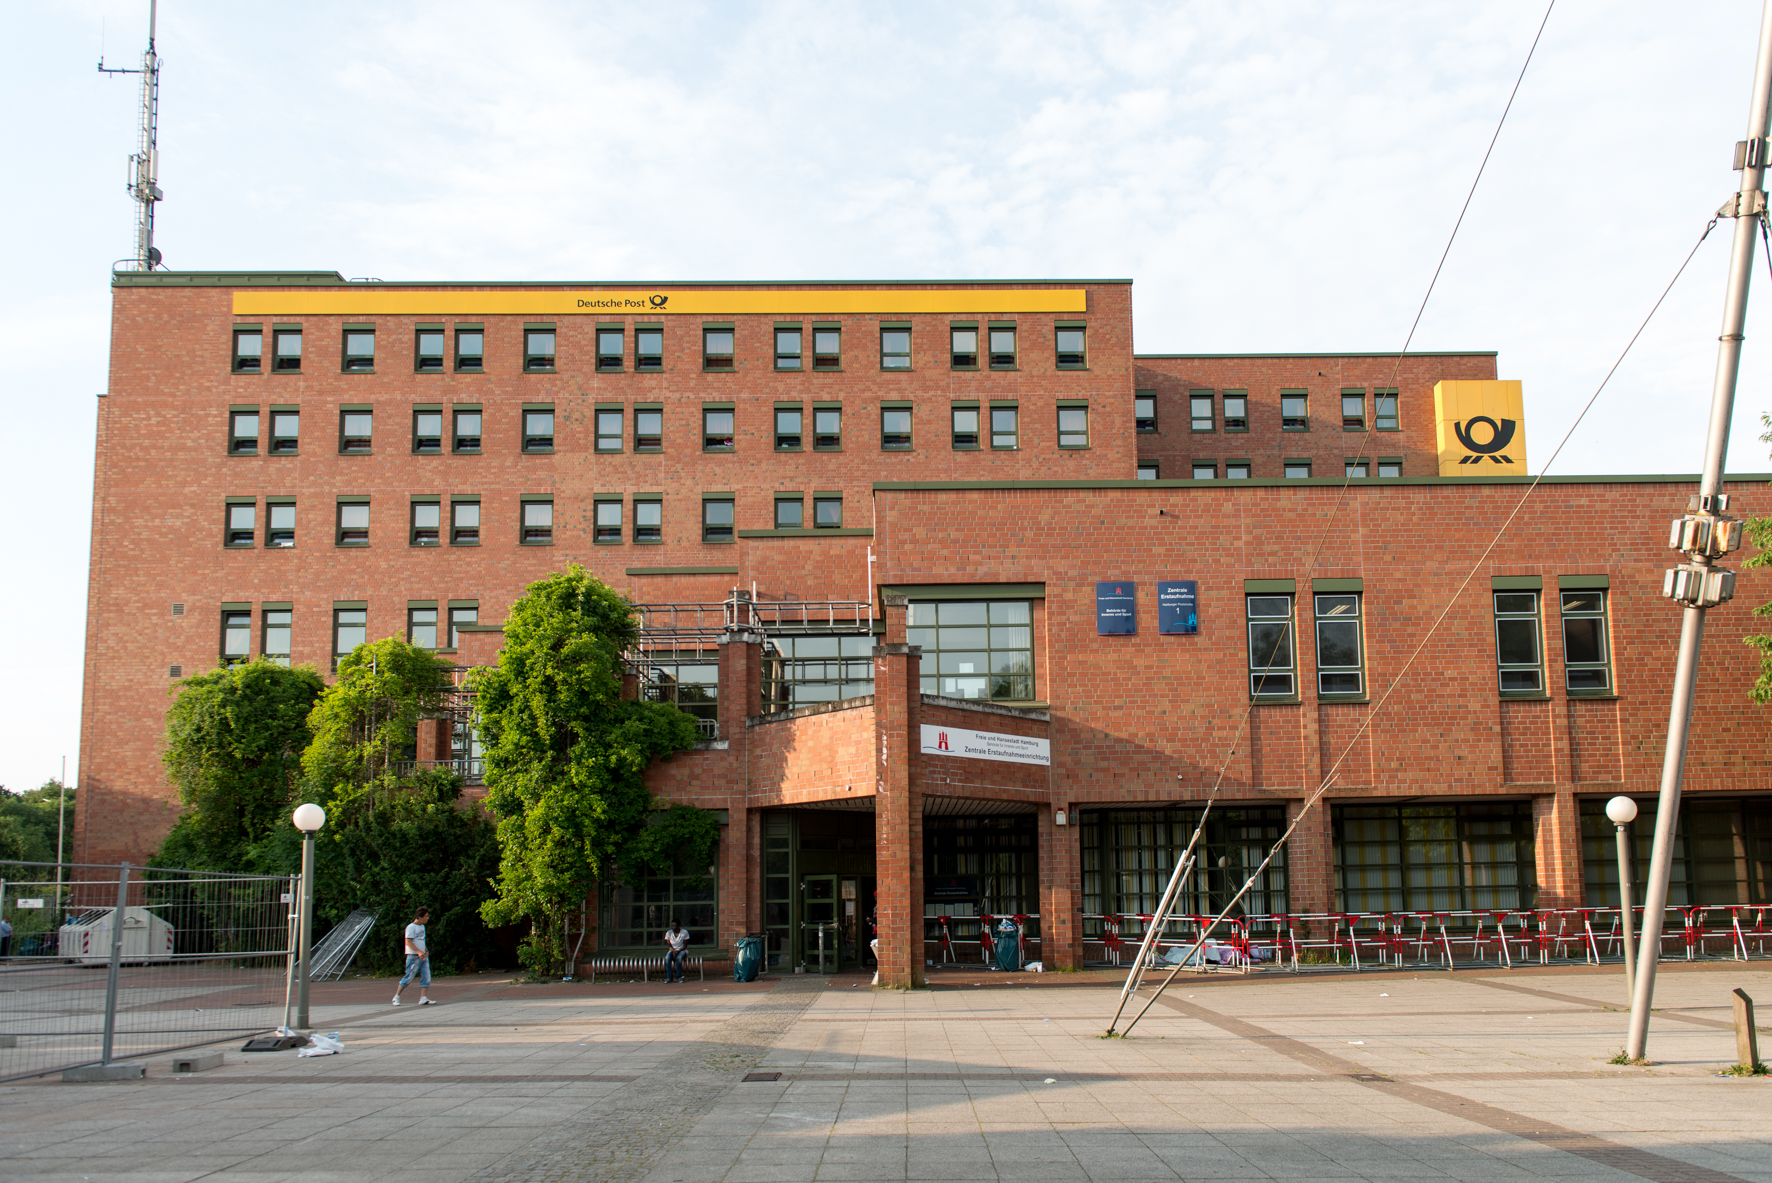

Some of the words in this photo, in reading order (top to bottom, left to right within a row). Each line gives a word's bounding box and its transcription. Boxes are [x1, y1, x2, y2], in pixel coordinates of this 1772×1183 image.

[577, 299, 622, 308] Deutsche
[624, 299, 646, 308] Post
[964, 746, 986, 754] Zentrale
[988, 749, 1049, 762] Erstaufnahmeeinrichtung
